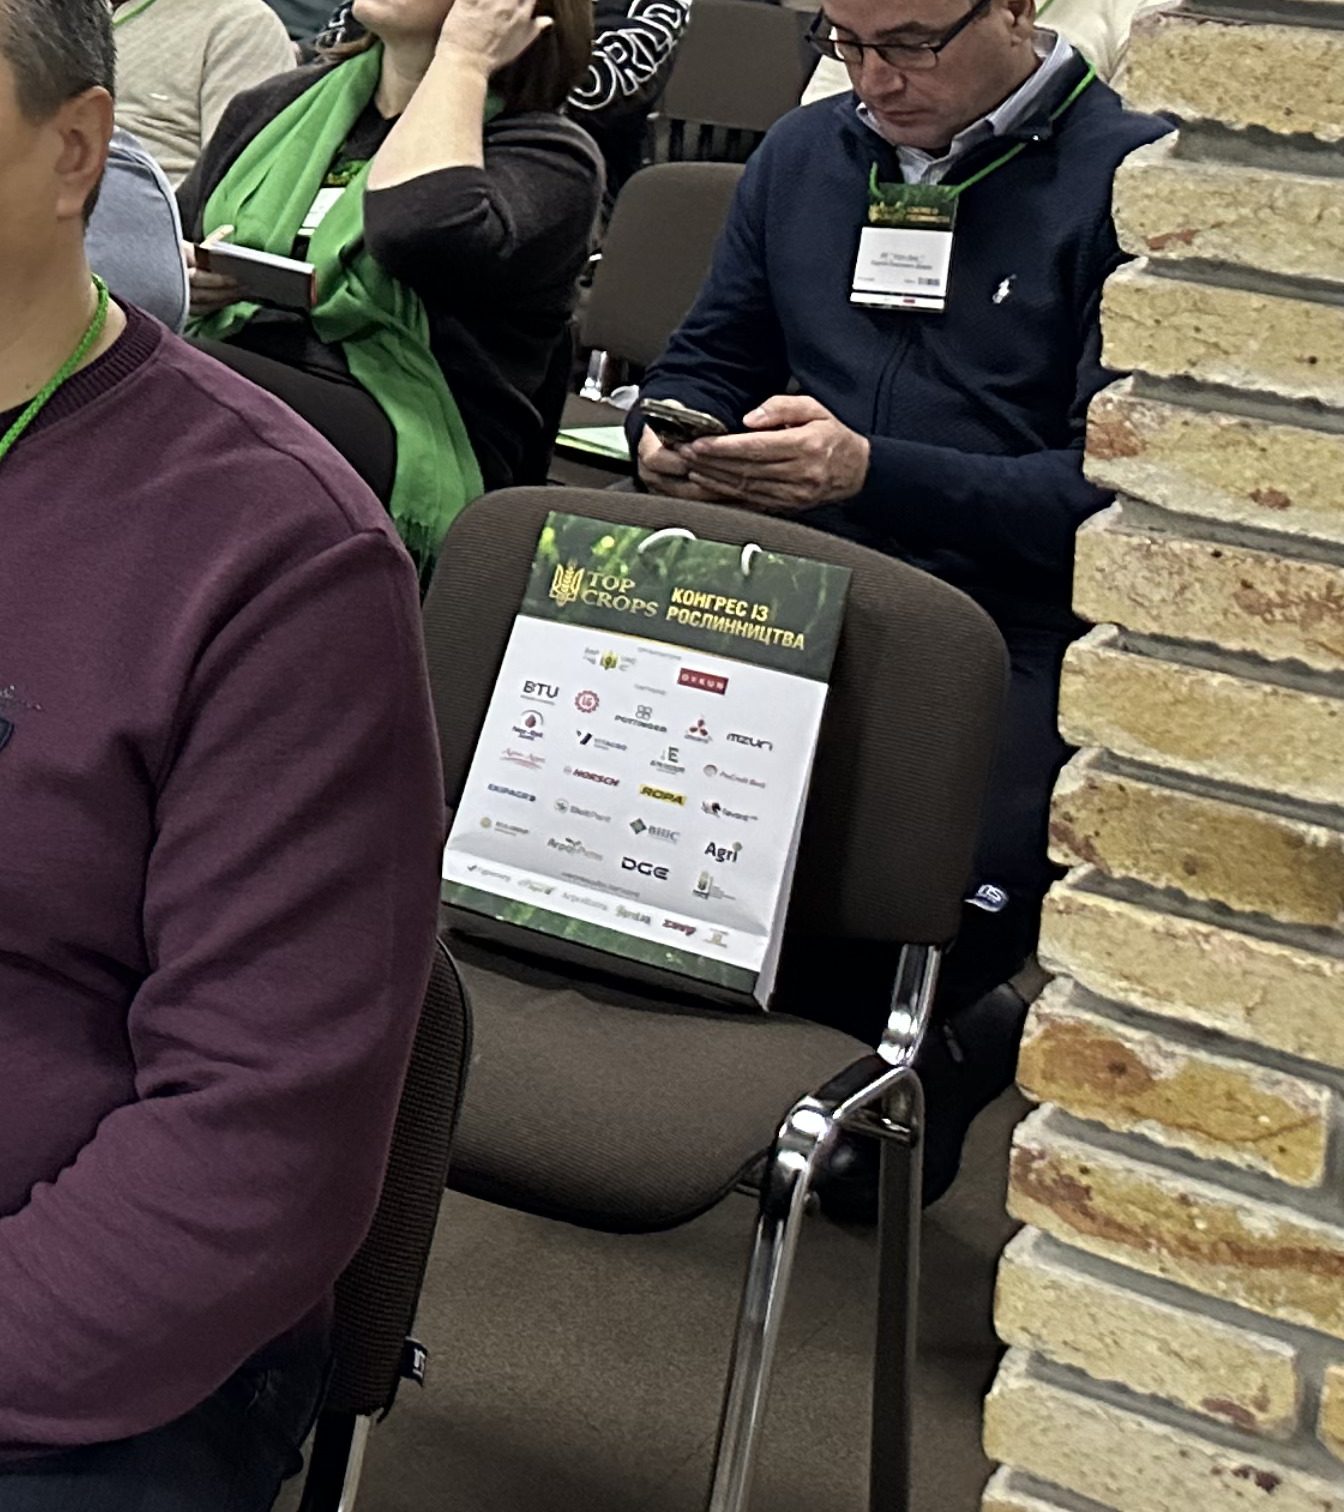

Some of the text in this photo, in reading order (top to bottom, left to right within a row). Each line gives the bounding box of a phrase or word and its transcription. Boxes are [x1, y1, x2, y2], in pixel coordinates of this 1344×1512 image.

[587, 571, 636, 593] TOP
[580, 590, 659, 618] CROPS
[670, 586, 770, 622] КОНГРЕС ІЗ
[665, 605, 805, 651] РОСЛИННИЦТВА
[522, 679, 559, 699] BTU
[573, 768, 620, 787] HORSCH
[640, 786, 685, 807] ROPA
[704, 841, 743, 863] Agri
